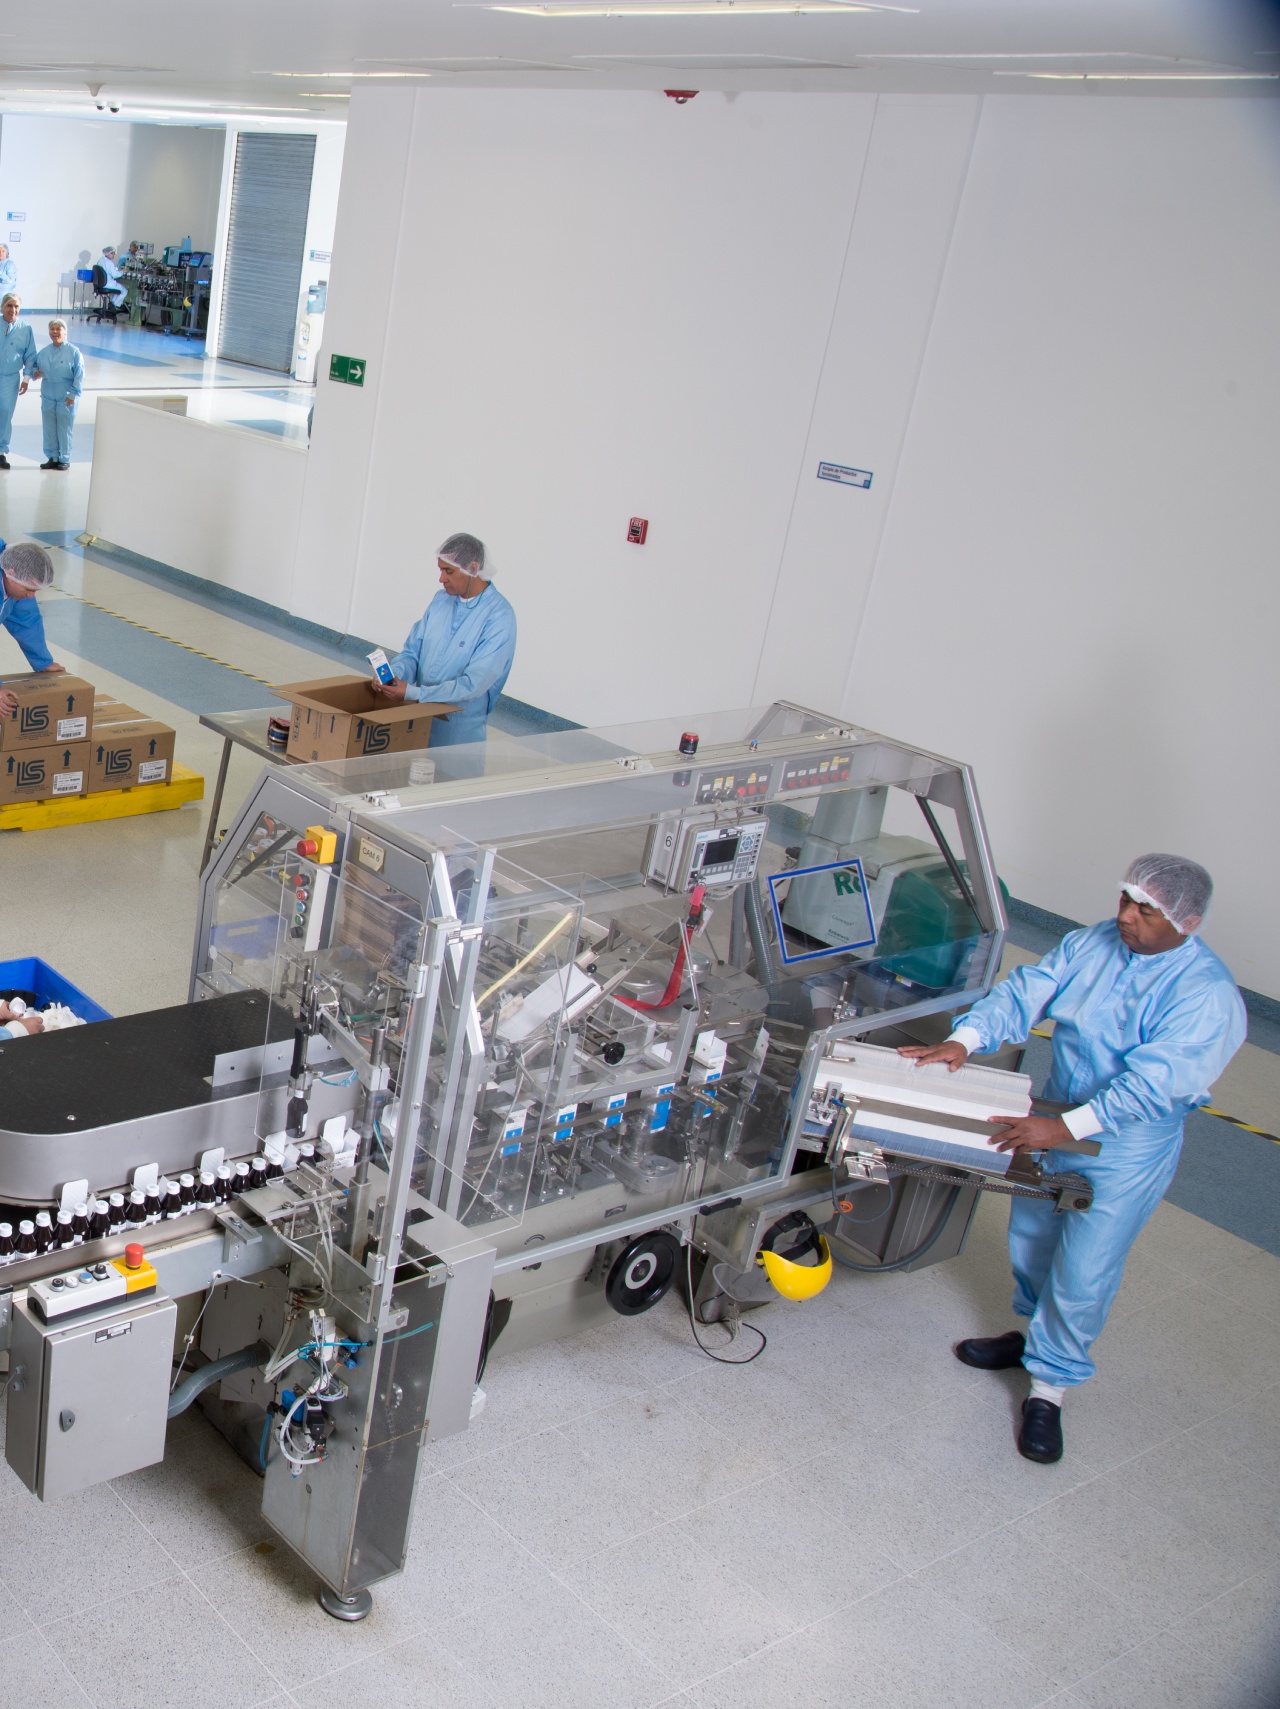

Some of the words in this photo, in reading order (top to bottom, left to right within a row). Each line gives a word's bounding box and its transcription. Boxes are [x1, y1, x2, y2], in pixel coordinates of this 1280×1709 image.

[20, 704, 49, 733] LS
[363, 723, 391, 755] LS
[16, 759, 46, 787] LS
[105, 748, 132, 775] LS
[362, 847, 376, 859] CAM
[665, 836, 673, 847] 6
